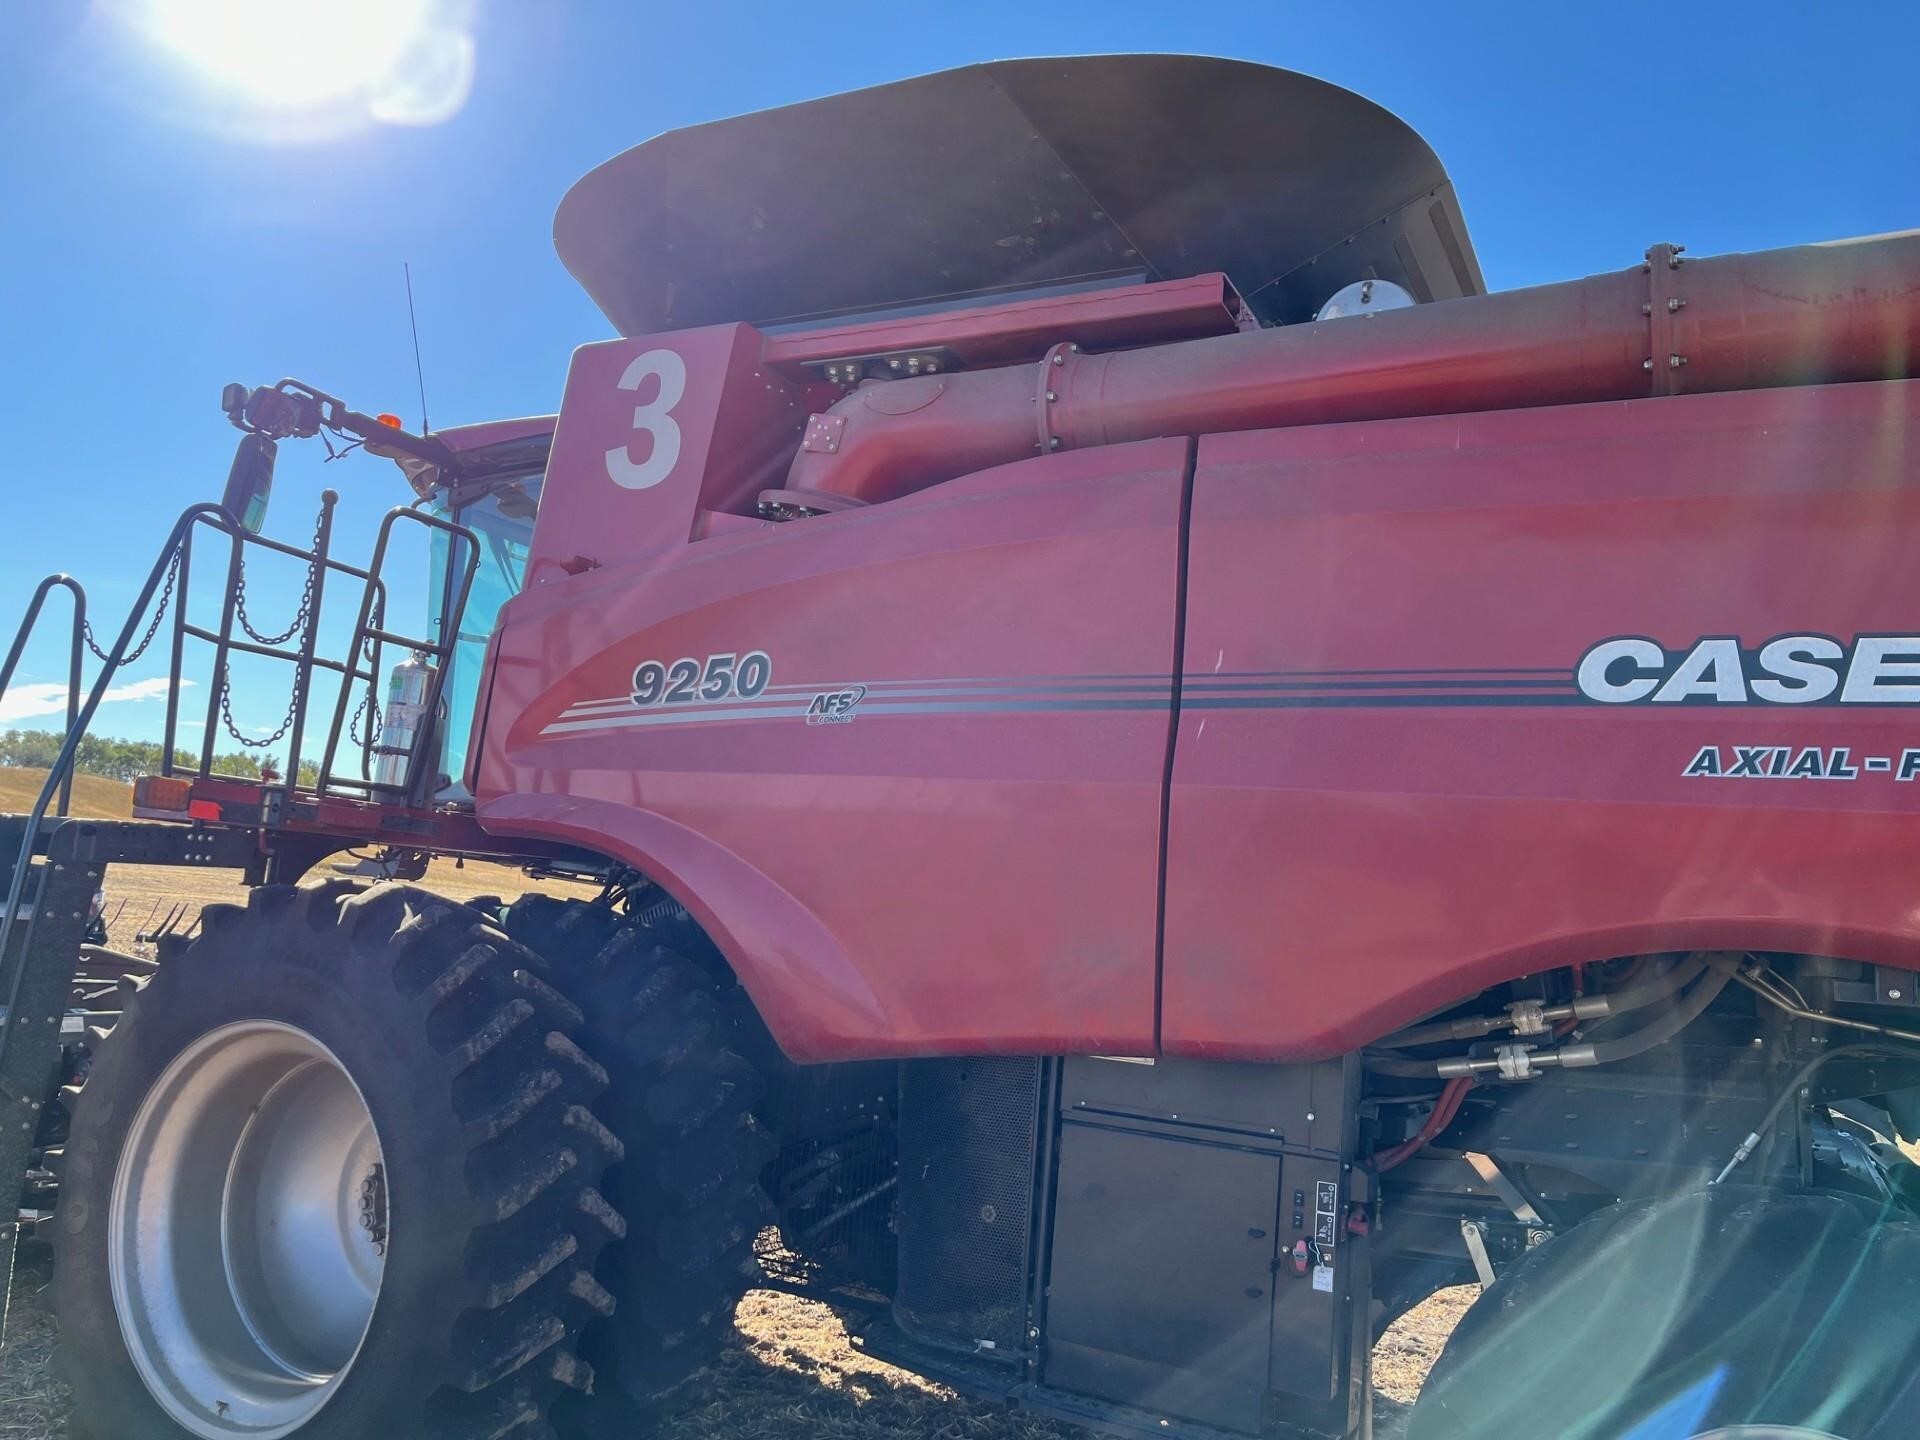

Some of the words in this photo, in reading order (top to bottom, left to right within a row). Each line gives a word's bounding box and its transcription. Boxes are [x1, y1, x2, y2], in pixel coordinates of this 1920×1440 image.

[605, 349, 686, 490] 3
[631, 650, 771, 706] 9250
[1577, 636, 1920, 704] CASE
[807, 692, 854, 715] AFS
[817, 714, 856, 724] CONNECT
